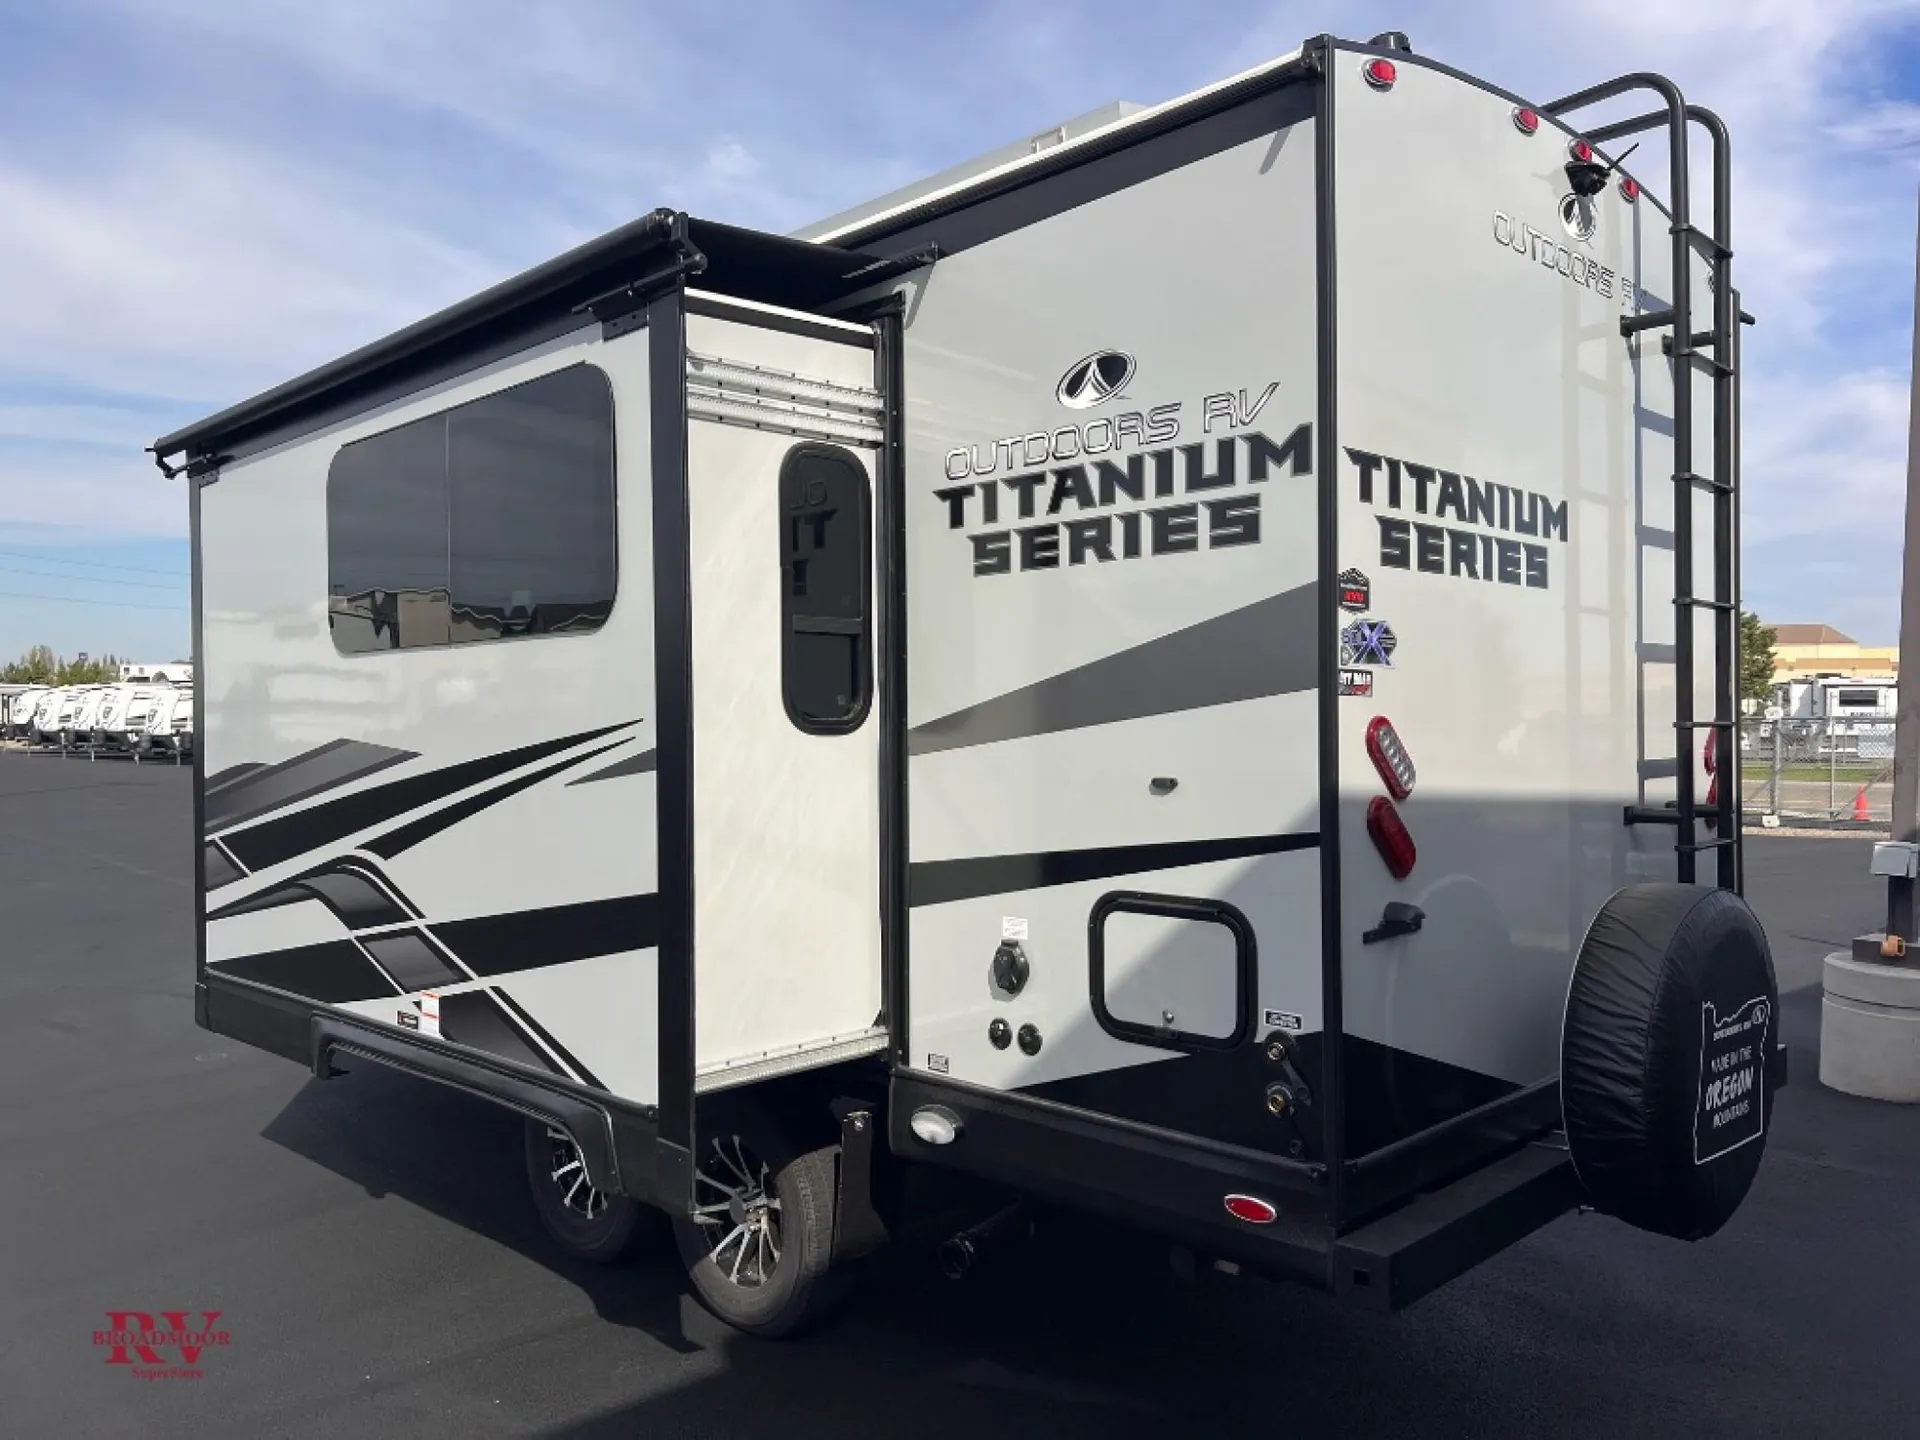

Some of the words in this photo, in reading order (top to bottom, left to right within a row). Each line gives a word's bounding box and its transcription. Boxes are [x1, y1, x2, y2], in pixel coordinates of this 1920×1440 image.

[1492, 209, 1615, 299] OUTDOORS
[932, 422, 1313, 529] TITANIUM
[944, 402, 1183, 480] OUTDOORS
[1203, 381, 1281, 433] RV
[966, 493, 1262, 577] SERIES
[1342, 445, 1569, 542] TITANIUM
[1374, 514, 1549, 589] SERIES
[1705, 1065, 1754, 1111] OREGON
